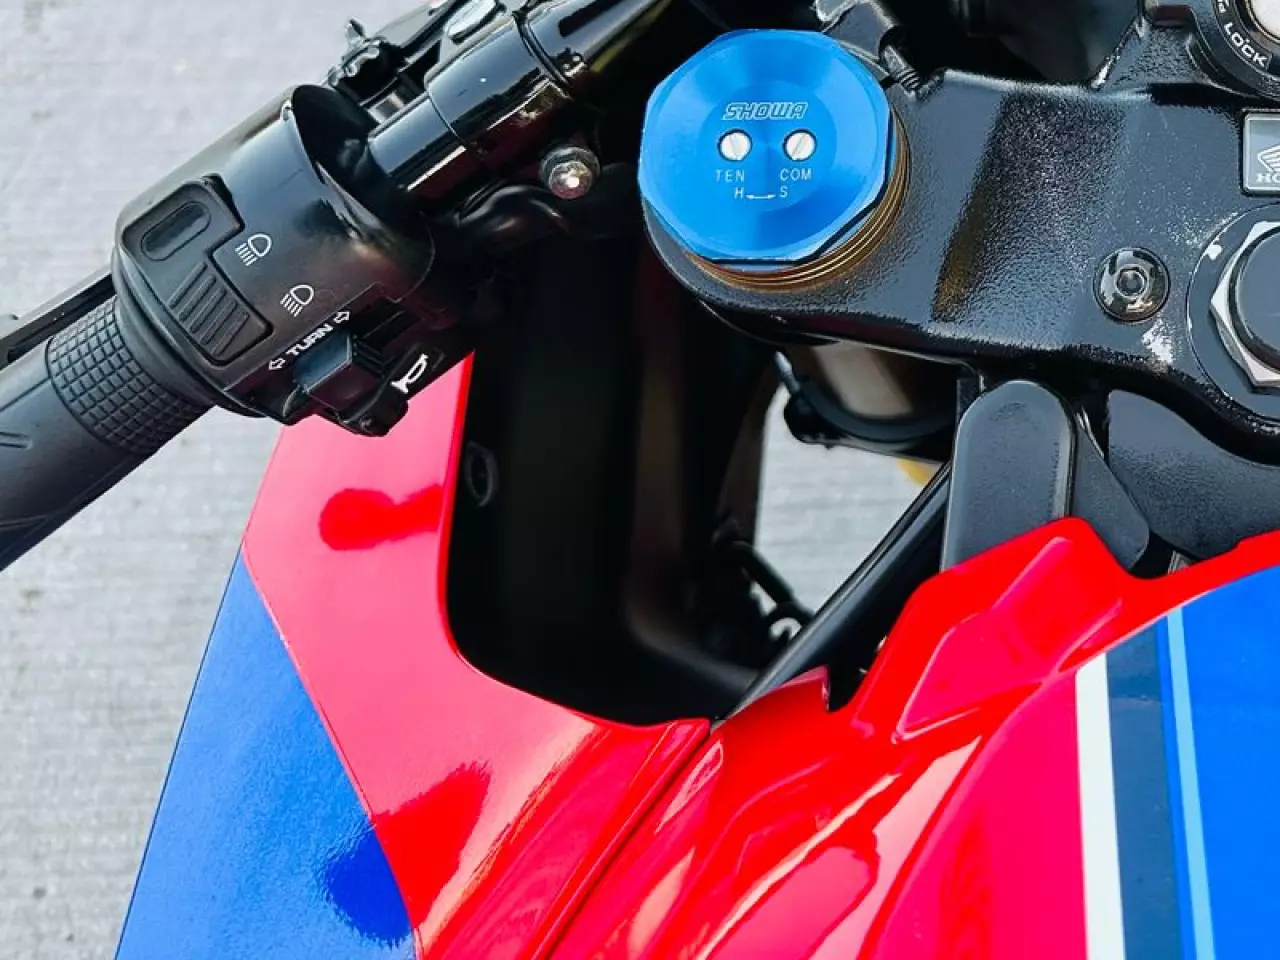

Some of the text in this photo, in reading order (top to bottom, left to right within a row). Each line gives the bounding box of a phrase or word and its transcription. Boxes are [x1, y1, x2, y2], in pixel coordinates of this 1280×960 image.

[1224, 22, 1268, 68] LOCK
[721, 101, 809, 121] SHOWA
[715, 168, 812, 182] TEN COM
[734, 186, 789, 199] H S
[285, 323, 334, 356] TURN
